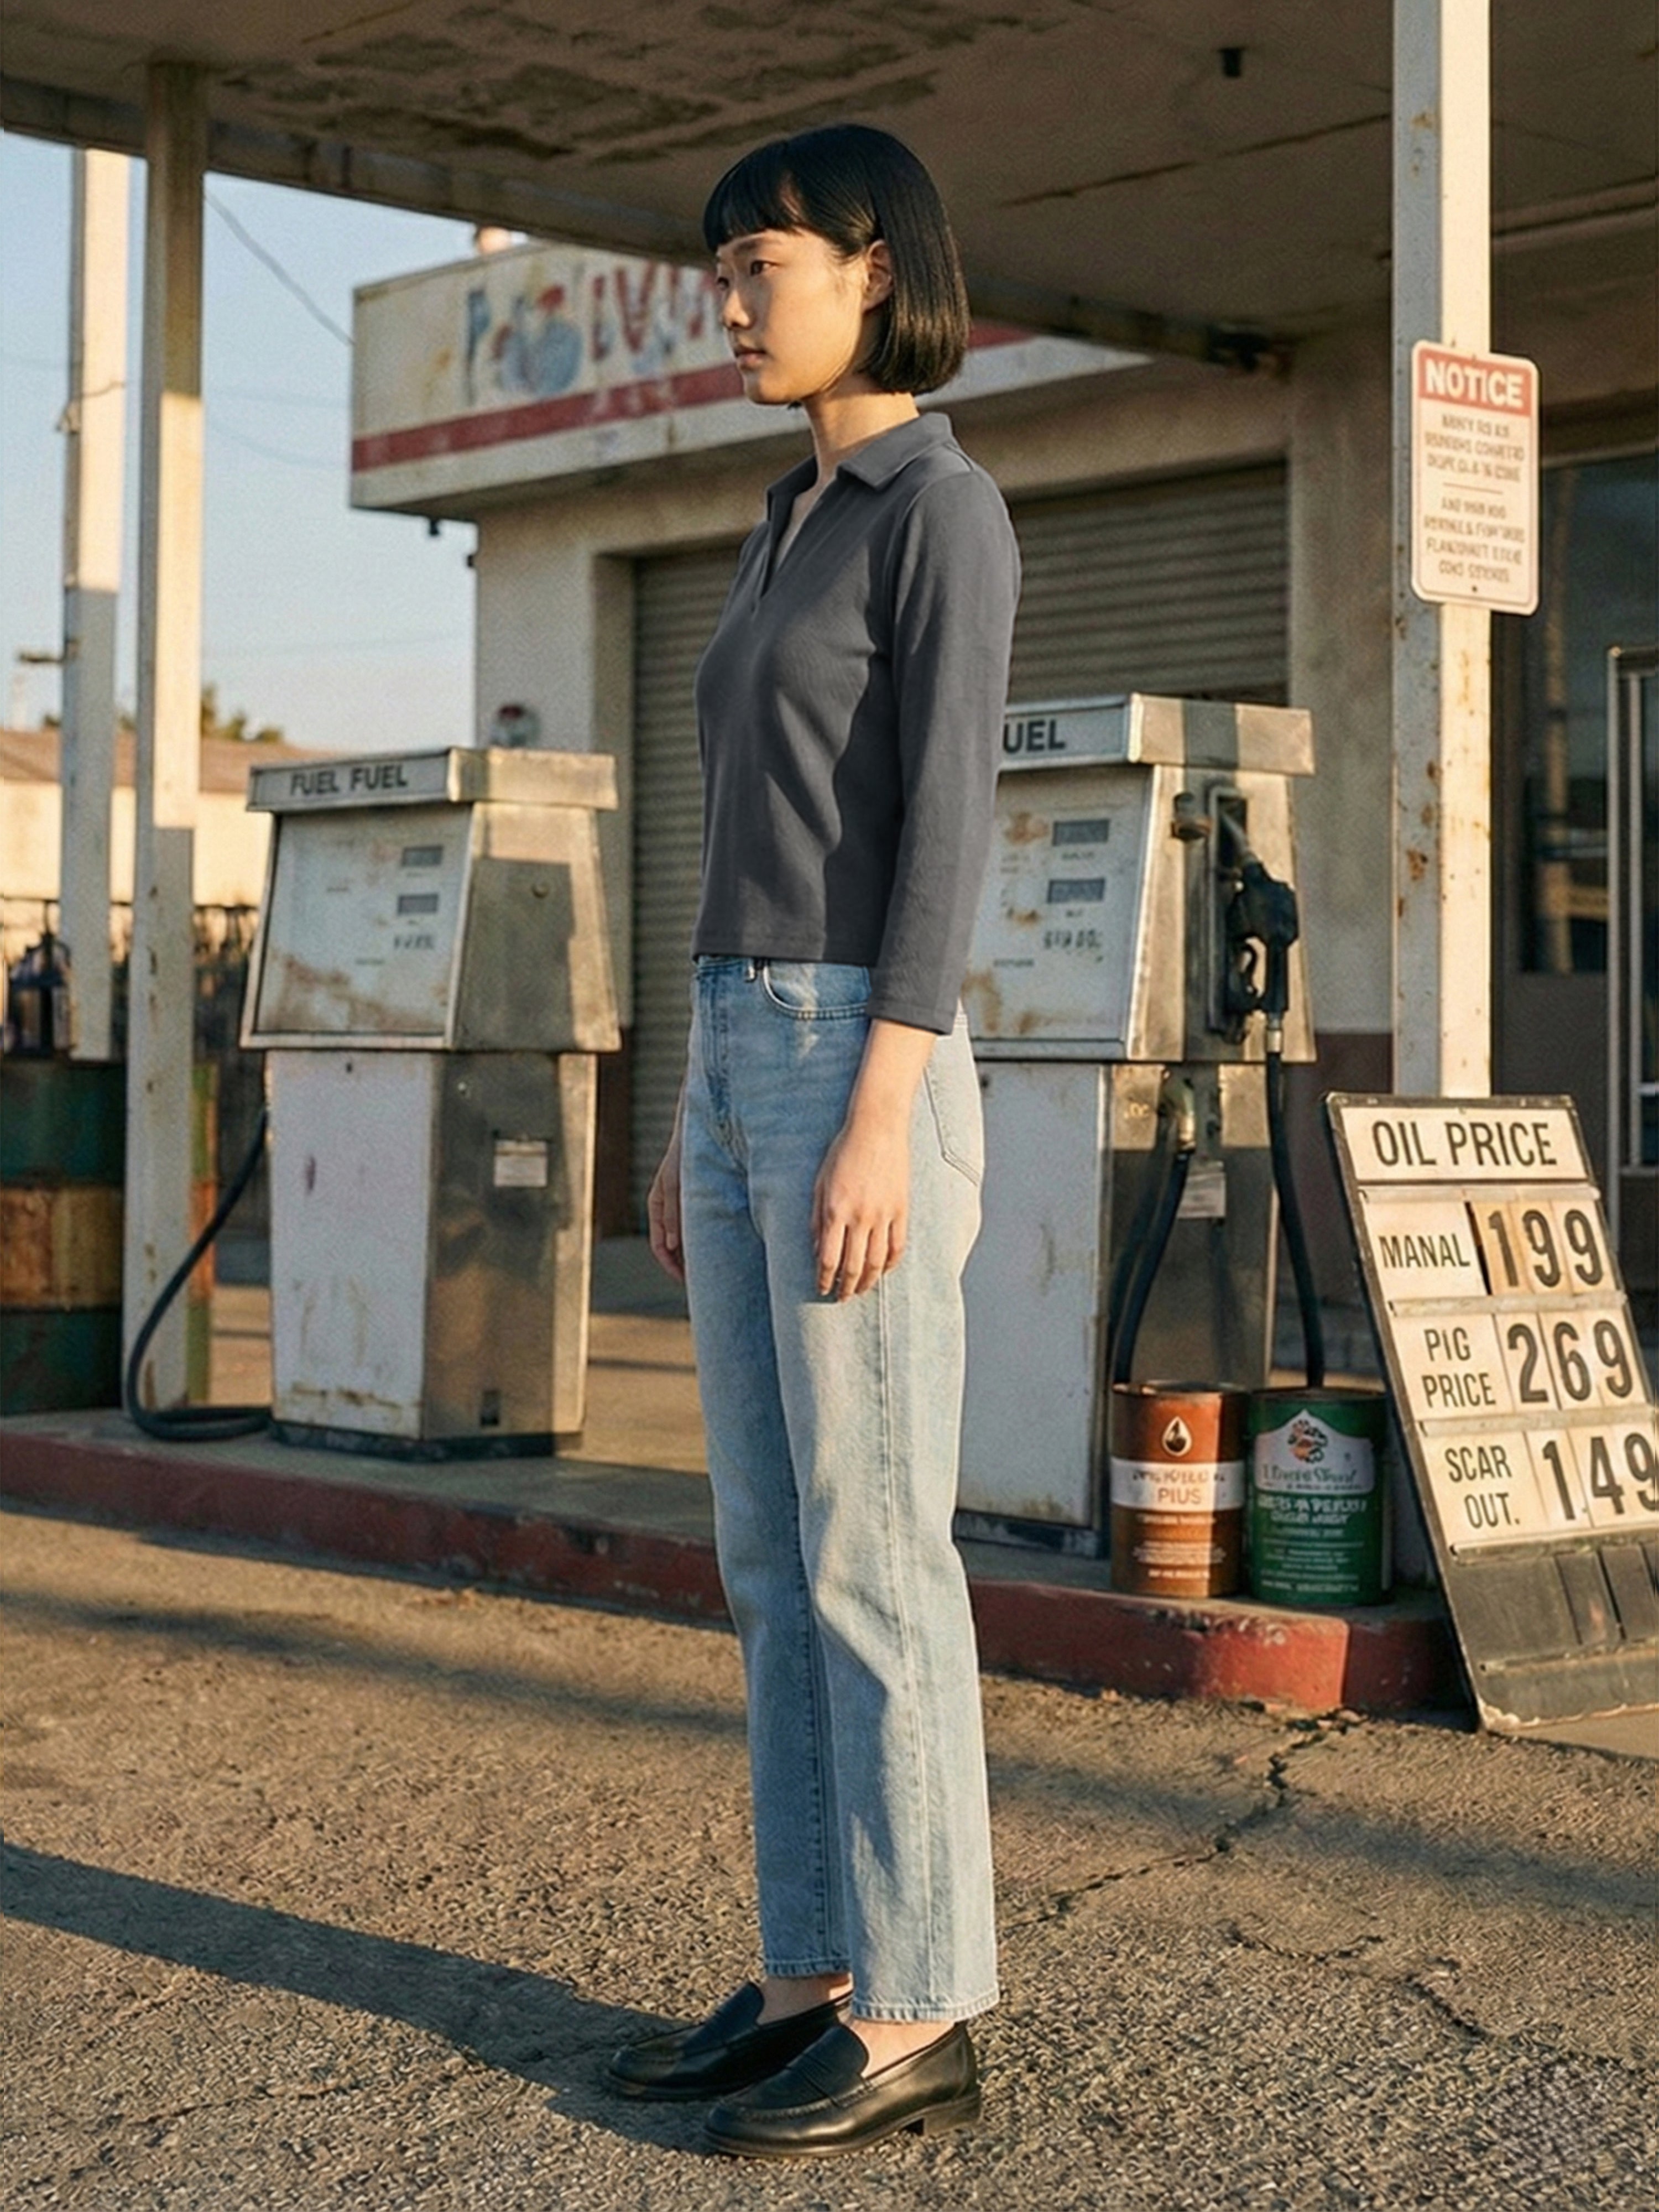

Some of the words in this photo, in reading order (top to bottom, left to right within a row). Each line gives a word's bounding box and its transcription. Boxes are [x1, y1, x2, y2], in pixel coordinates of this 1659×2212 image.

[1426, 359, 1524, 408] NOTICE
[1003, 719, 1066, 754] UEL
[290, 770, 340, 796] FUEL
[350, 763, 408, 791] FUEL
[1372, 1120, 1437, 1167] OIL
[1444, 1121, 1557, 1167] PRICE
[1379, 1233, 1471, 1269] MANAL
[1488, 1208, 1603, 1288] 199
[1423, 1327, 1471, 1362] PIG
[1507, 1318, 1632, 1404] 269
[1421, 1373, 1496, 1408] PRICE
[1444, 1445, 1512, 1483] SCAR
[1464, 1493, 1521, 1529] OUT.
